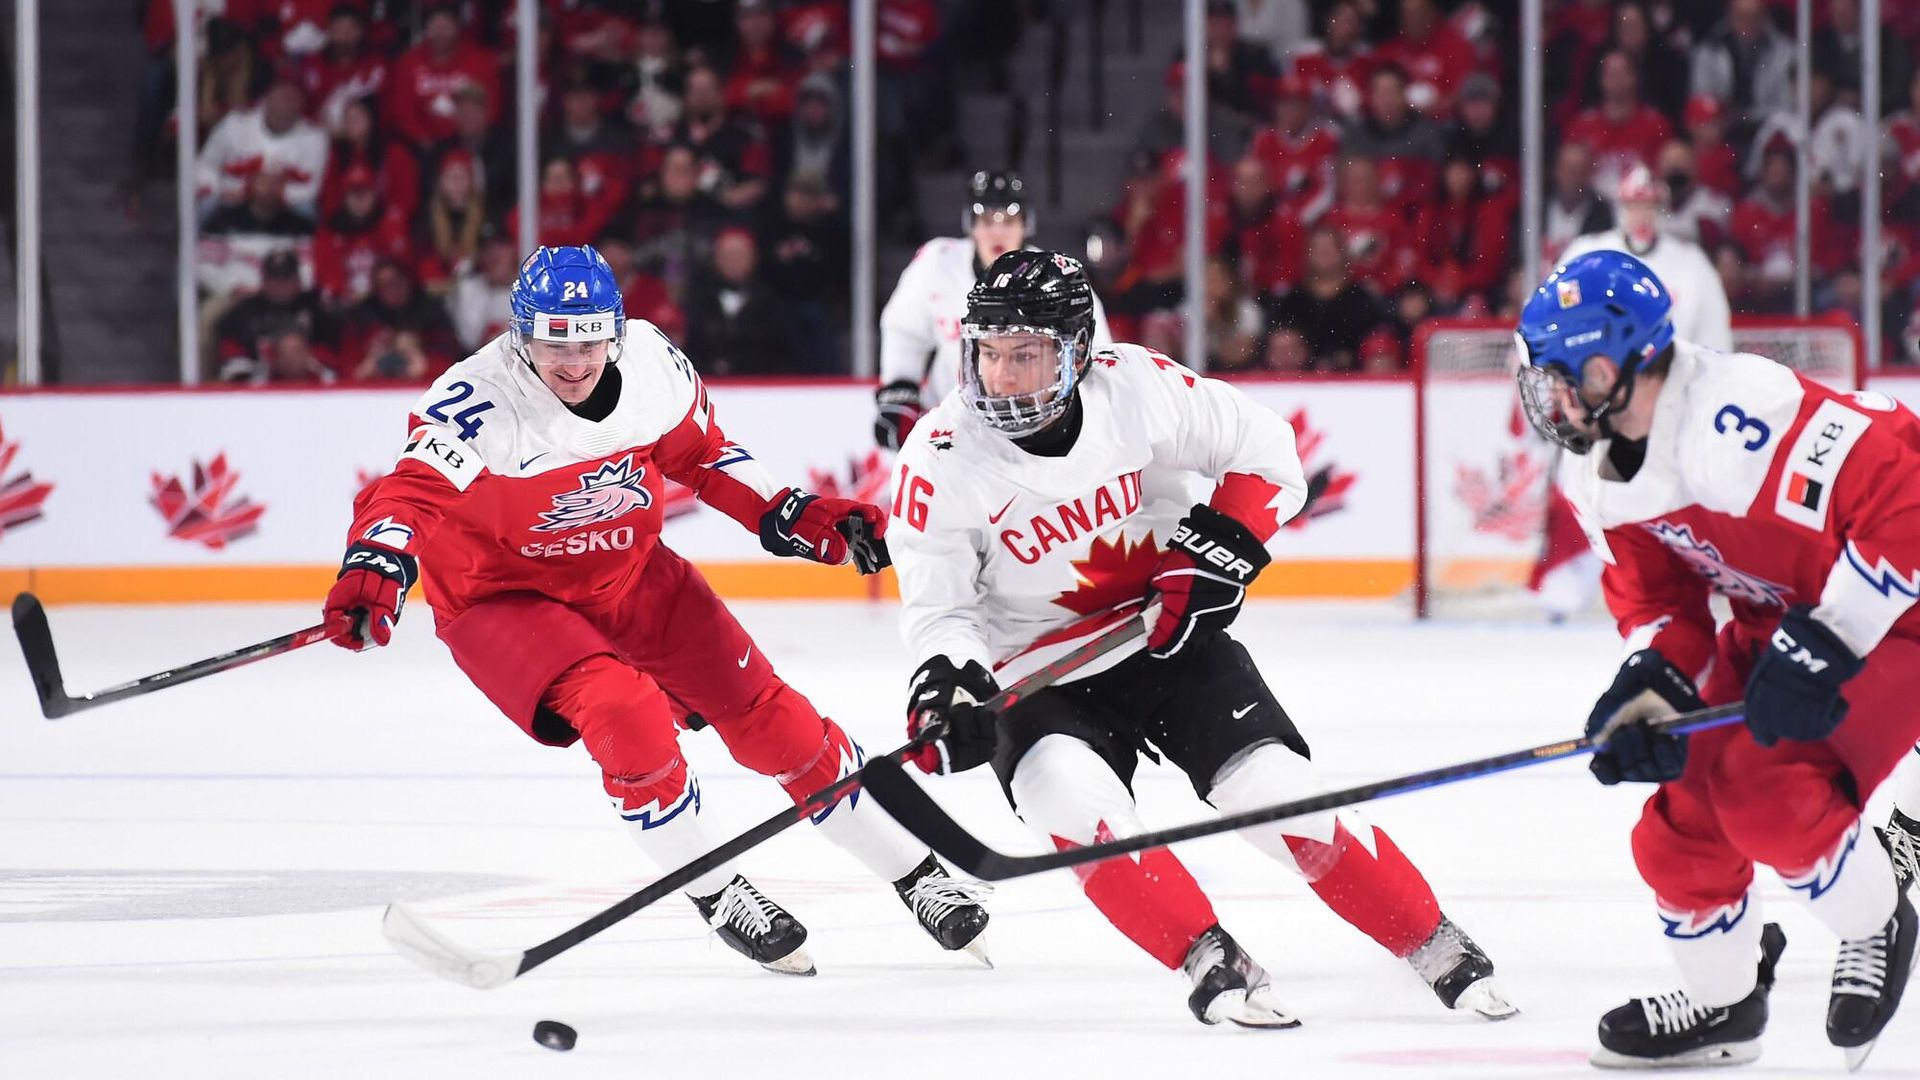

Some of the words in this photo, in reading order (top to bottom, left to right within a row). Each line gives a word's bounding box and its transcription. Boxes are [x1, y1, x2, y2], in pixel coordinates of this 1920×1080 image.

[564, 281, 588, 298] 24
[992, 273, 1012, 288] 16
[575, 322, 602, 333] KB
[426, 381, 495, 442] 24
[1714, 404, 1771, 452] 3
[424, 437, 464, 469] KB
[1807, 422, 1843, 466] KB
[893, 463, 934, 533] 16
[1000, 469, 1143, 564] CANAD
[1173, 524, 1254, 580] AUER
